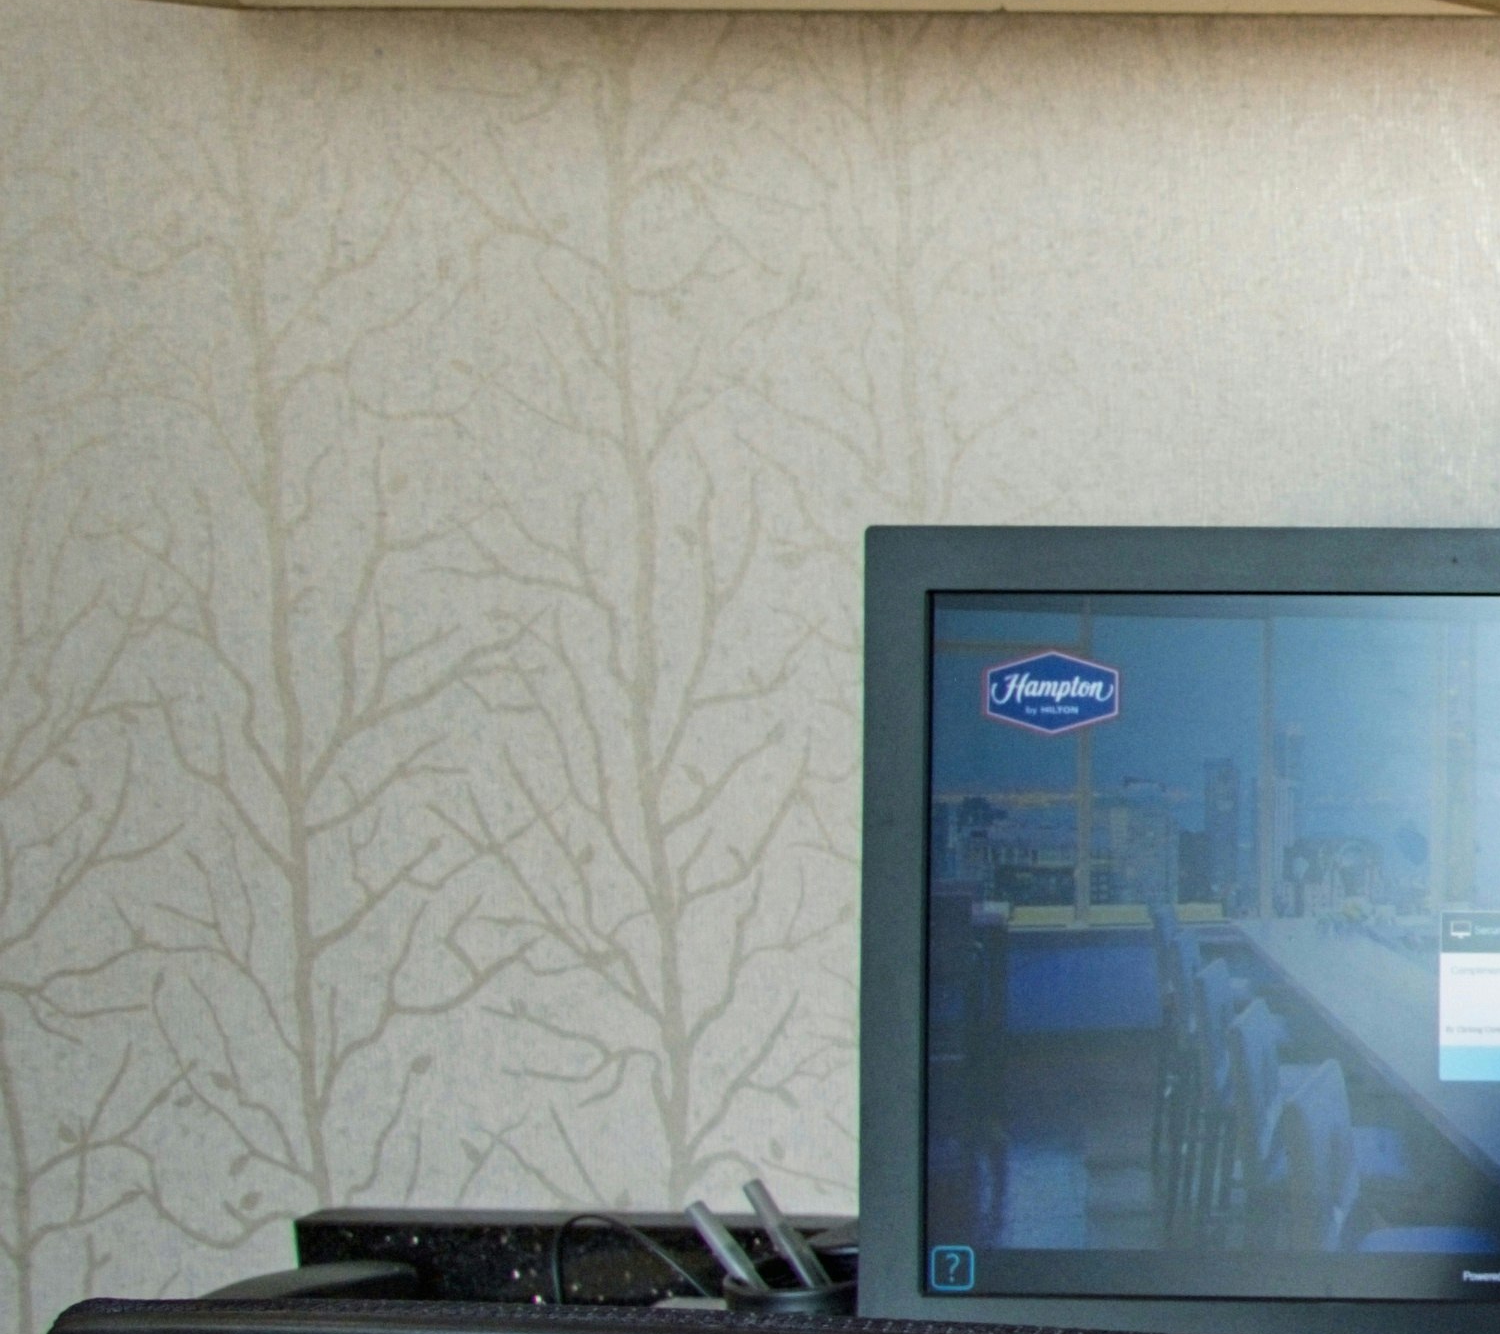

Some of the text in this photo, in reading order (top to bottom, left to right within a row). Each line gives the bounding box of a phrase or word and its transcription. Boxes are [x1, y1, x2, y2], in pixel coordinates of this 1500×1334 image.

[991, 672, 1114, 704] Hampton
[1025, 706, 1079, 715] by HILTON
[945, 1253, 960, 1283] ?
